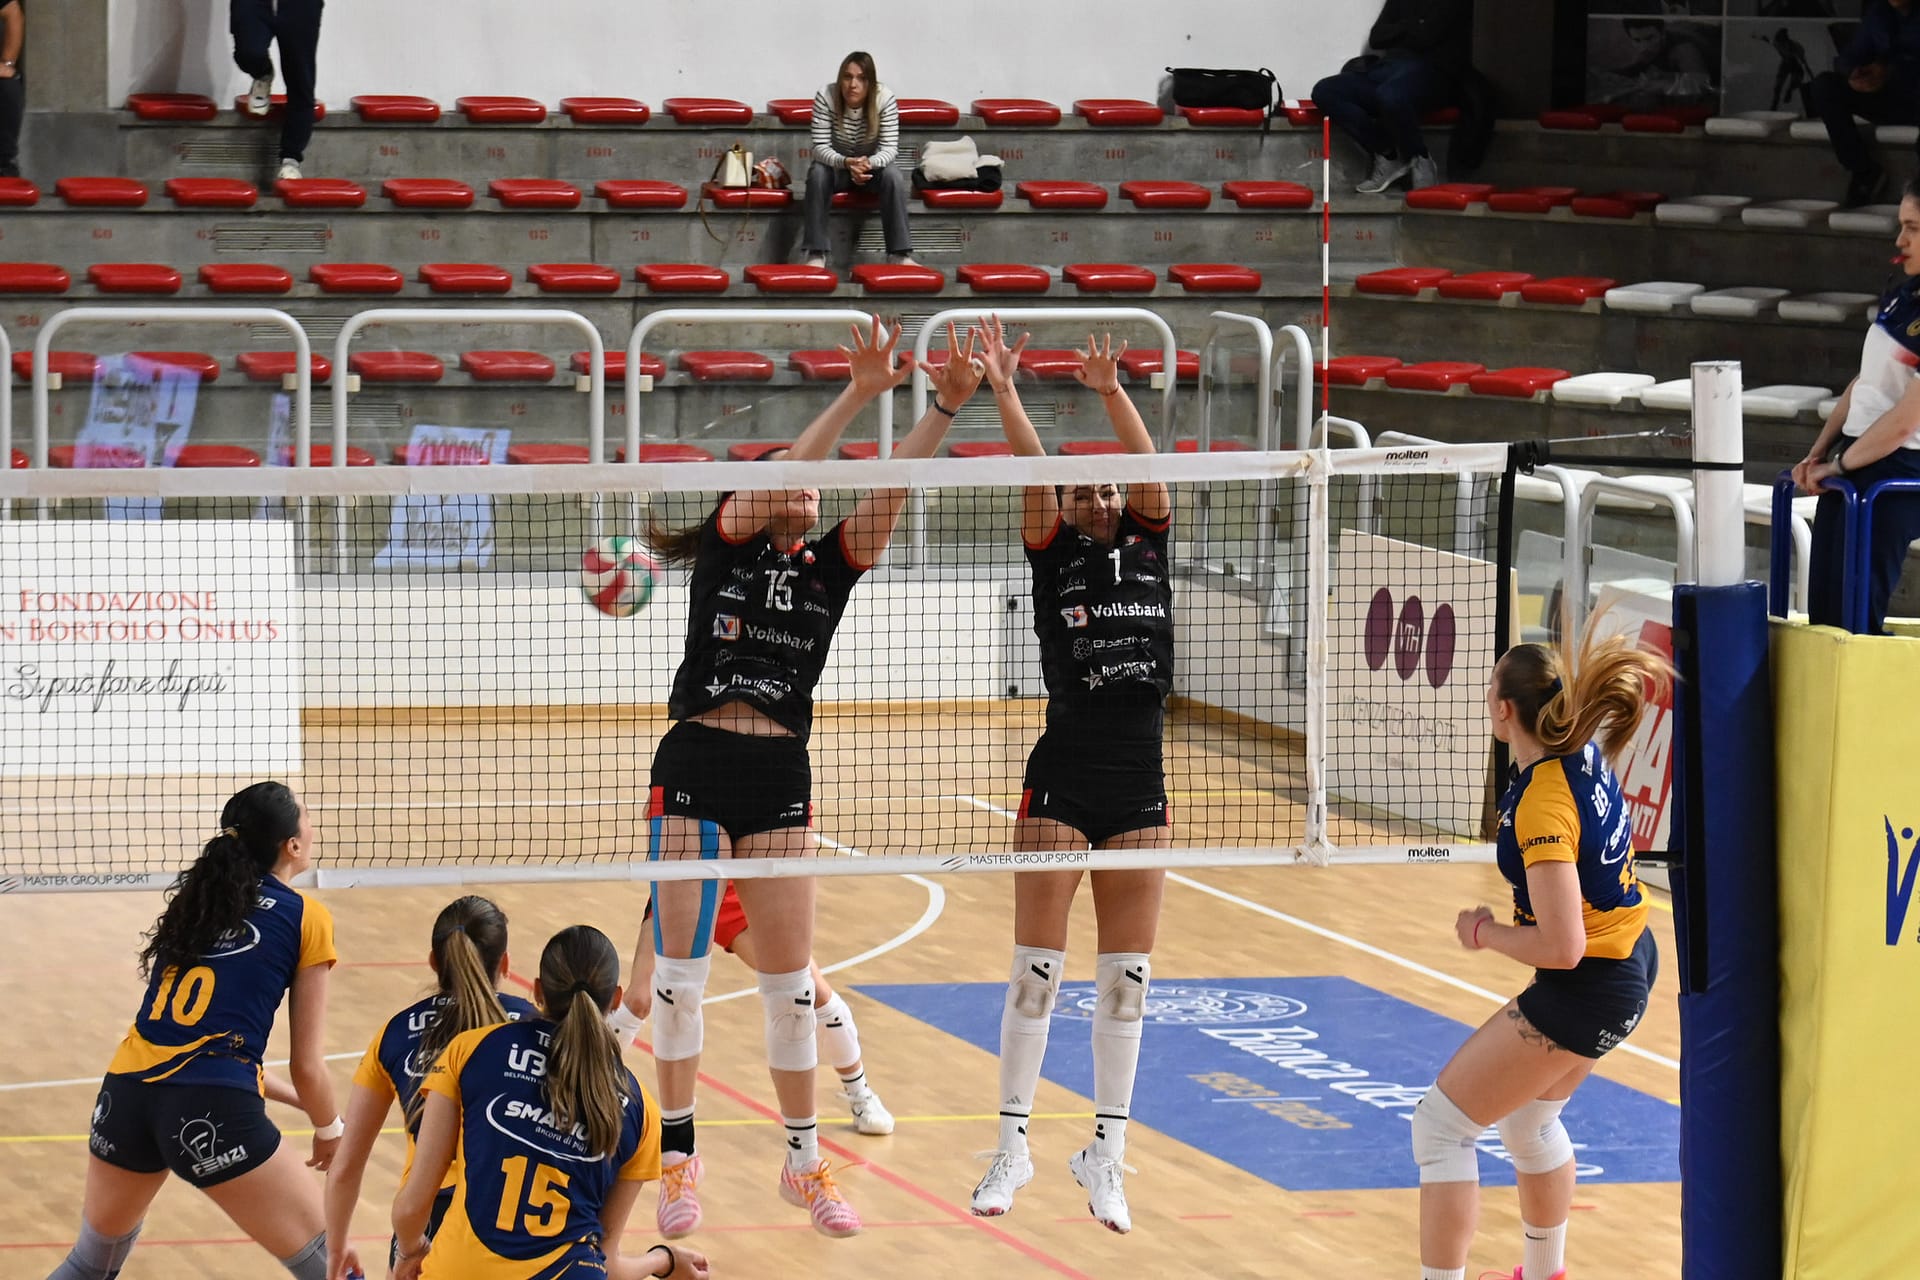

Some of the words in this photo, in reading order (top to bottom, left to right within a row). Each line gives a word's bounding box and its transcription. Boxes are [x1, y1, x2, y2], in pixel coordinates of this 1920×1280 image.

[1386, 449, 1429, 460] molten
[20, 588, 218, 612] FONDAZIONE
[765, 569, 799, 612] 15
[1091, 602, 1166, 619] Volksbank
[30, 616, 168, 642] BORTOLO
[179, 616, 279, 642] ONLUS
[969, 854, 1012, 865] MASTER
[1014, 853, 1054, 864] GROUP
[1055, 852, 1090, 863] SPORT
[1407, 846, 1450, 858] molten
[23, 876, 68, 886] MASTER
[70, 875, 112, 885] GROUP
[113, 873, 152, 884] SPORT
[148, 963, 216, 1027] 10
[1198, 1024, 1370, 1080] Banca
[503, 1071, 537, 1083] BELFANTI
[535, 1125, 562, 1142] ancora
[191, 1144, 248, 1176] FENZI
[495, 1155, 571, 1238] 15
